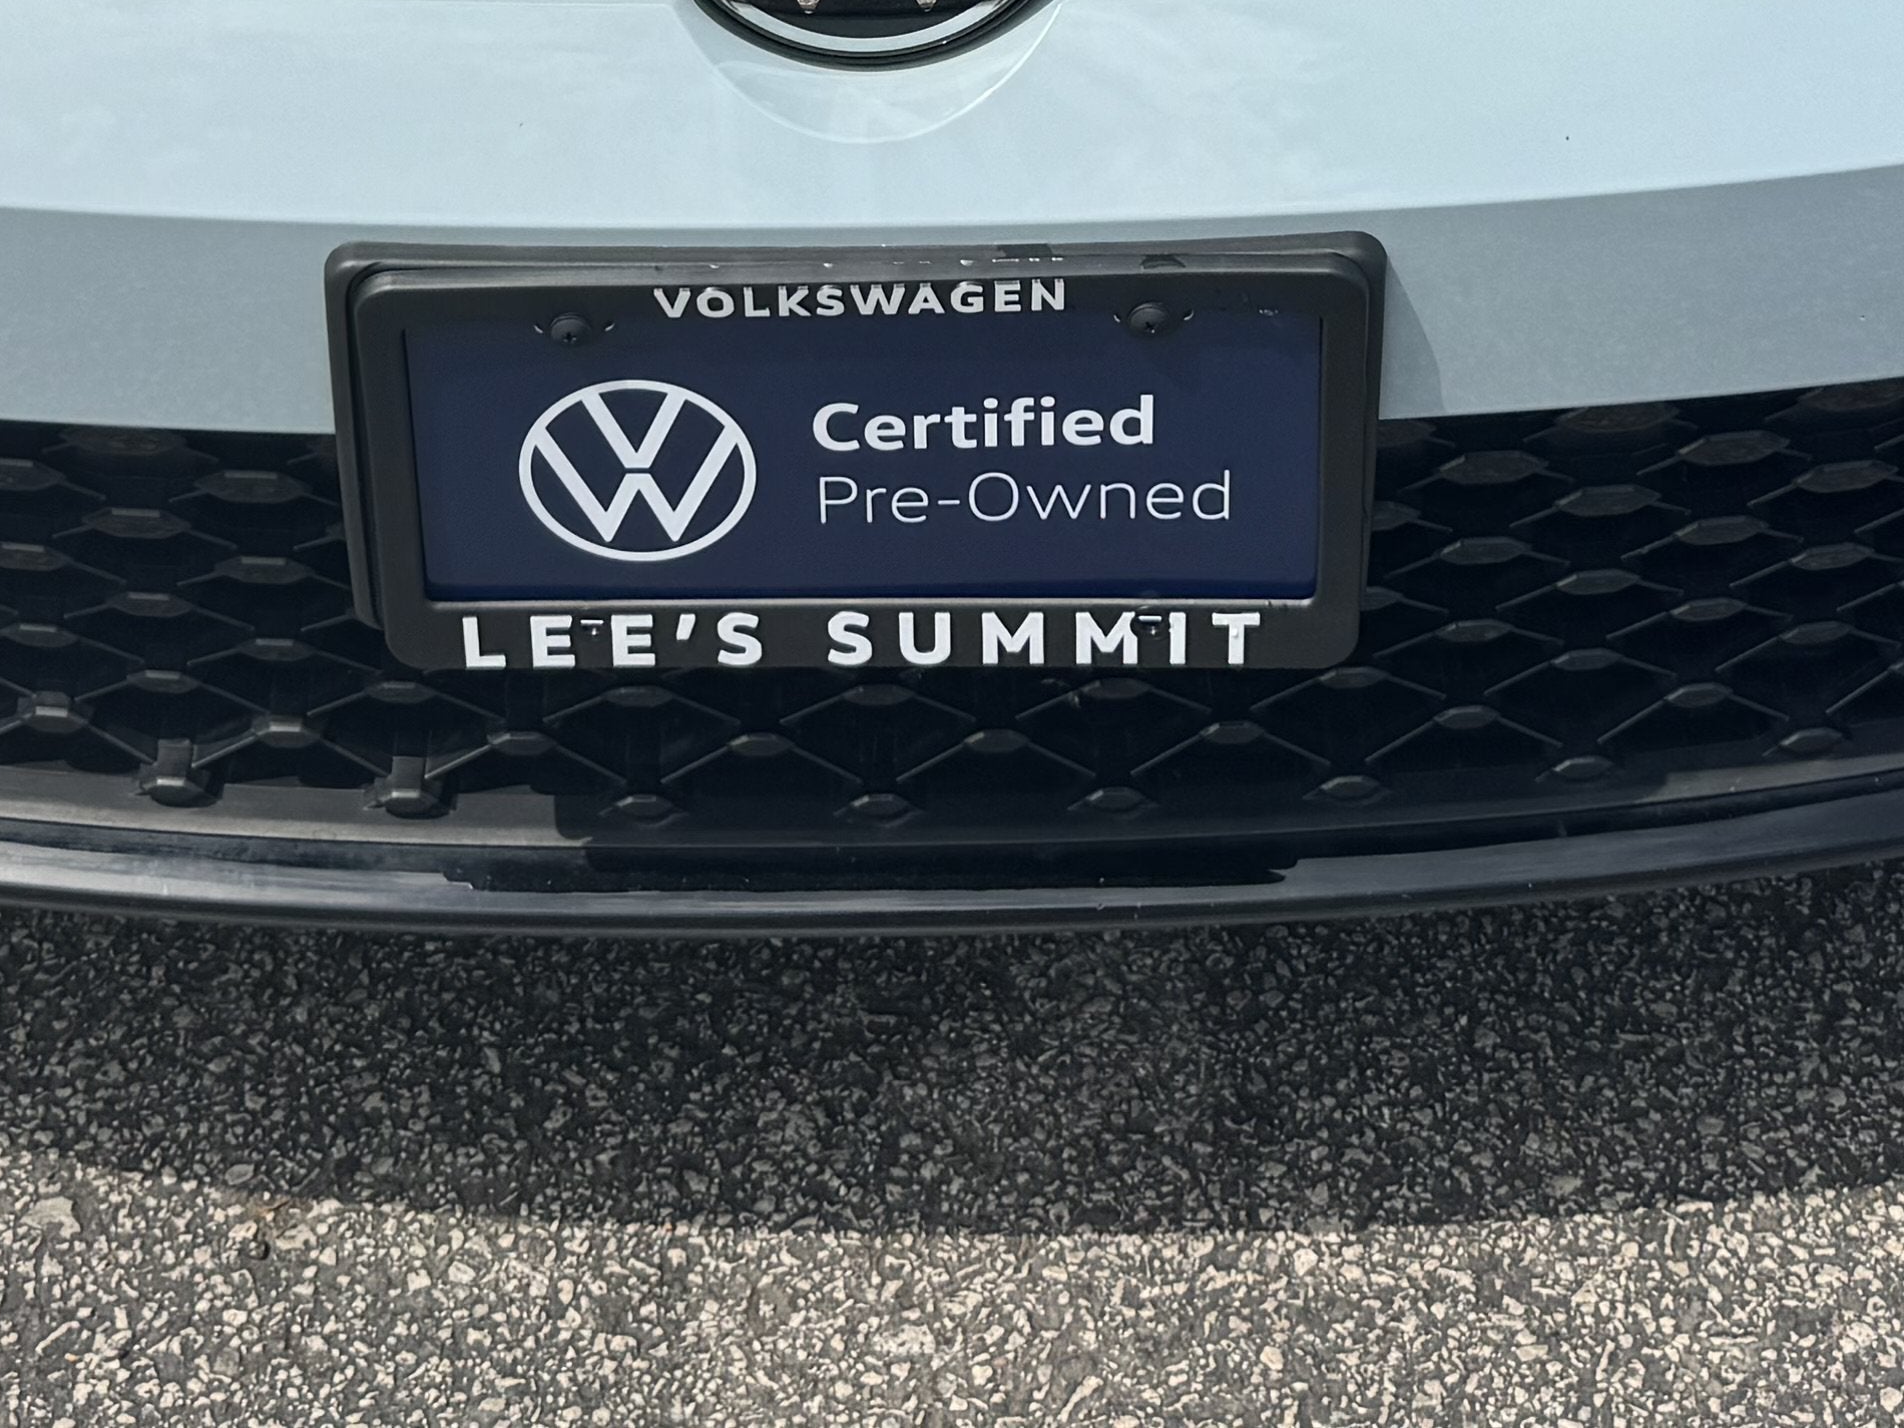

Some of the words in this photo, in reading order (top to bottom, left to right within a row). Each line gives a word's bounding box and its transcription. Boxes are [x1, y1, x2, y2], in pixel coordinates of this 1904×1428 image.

[653, 278, 1066, 319] VOLKSWAGEN
[812, 394, 1154, 452] Certified
[524, 383, 750, 554] VW
[818, 469, 1231, 525] Pre-Owned
[462, 611, 763, 669] LEE'S
[826, 610, 1262, 667] SUMMIT
